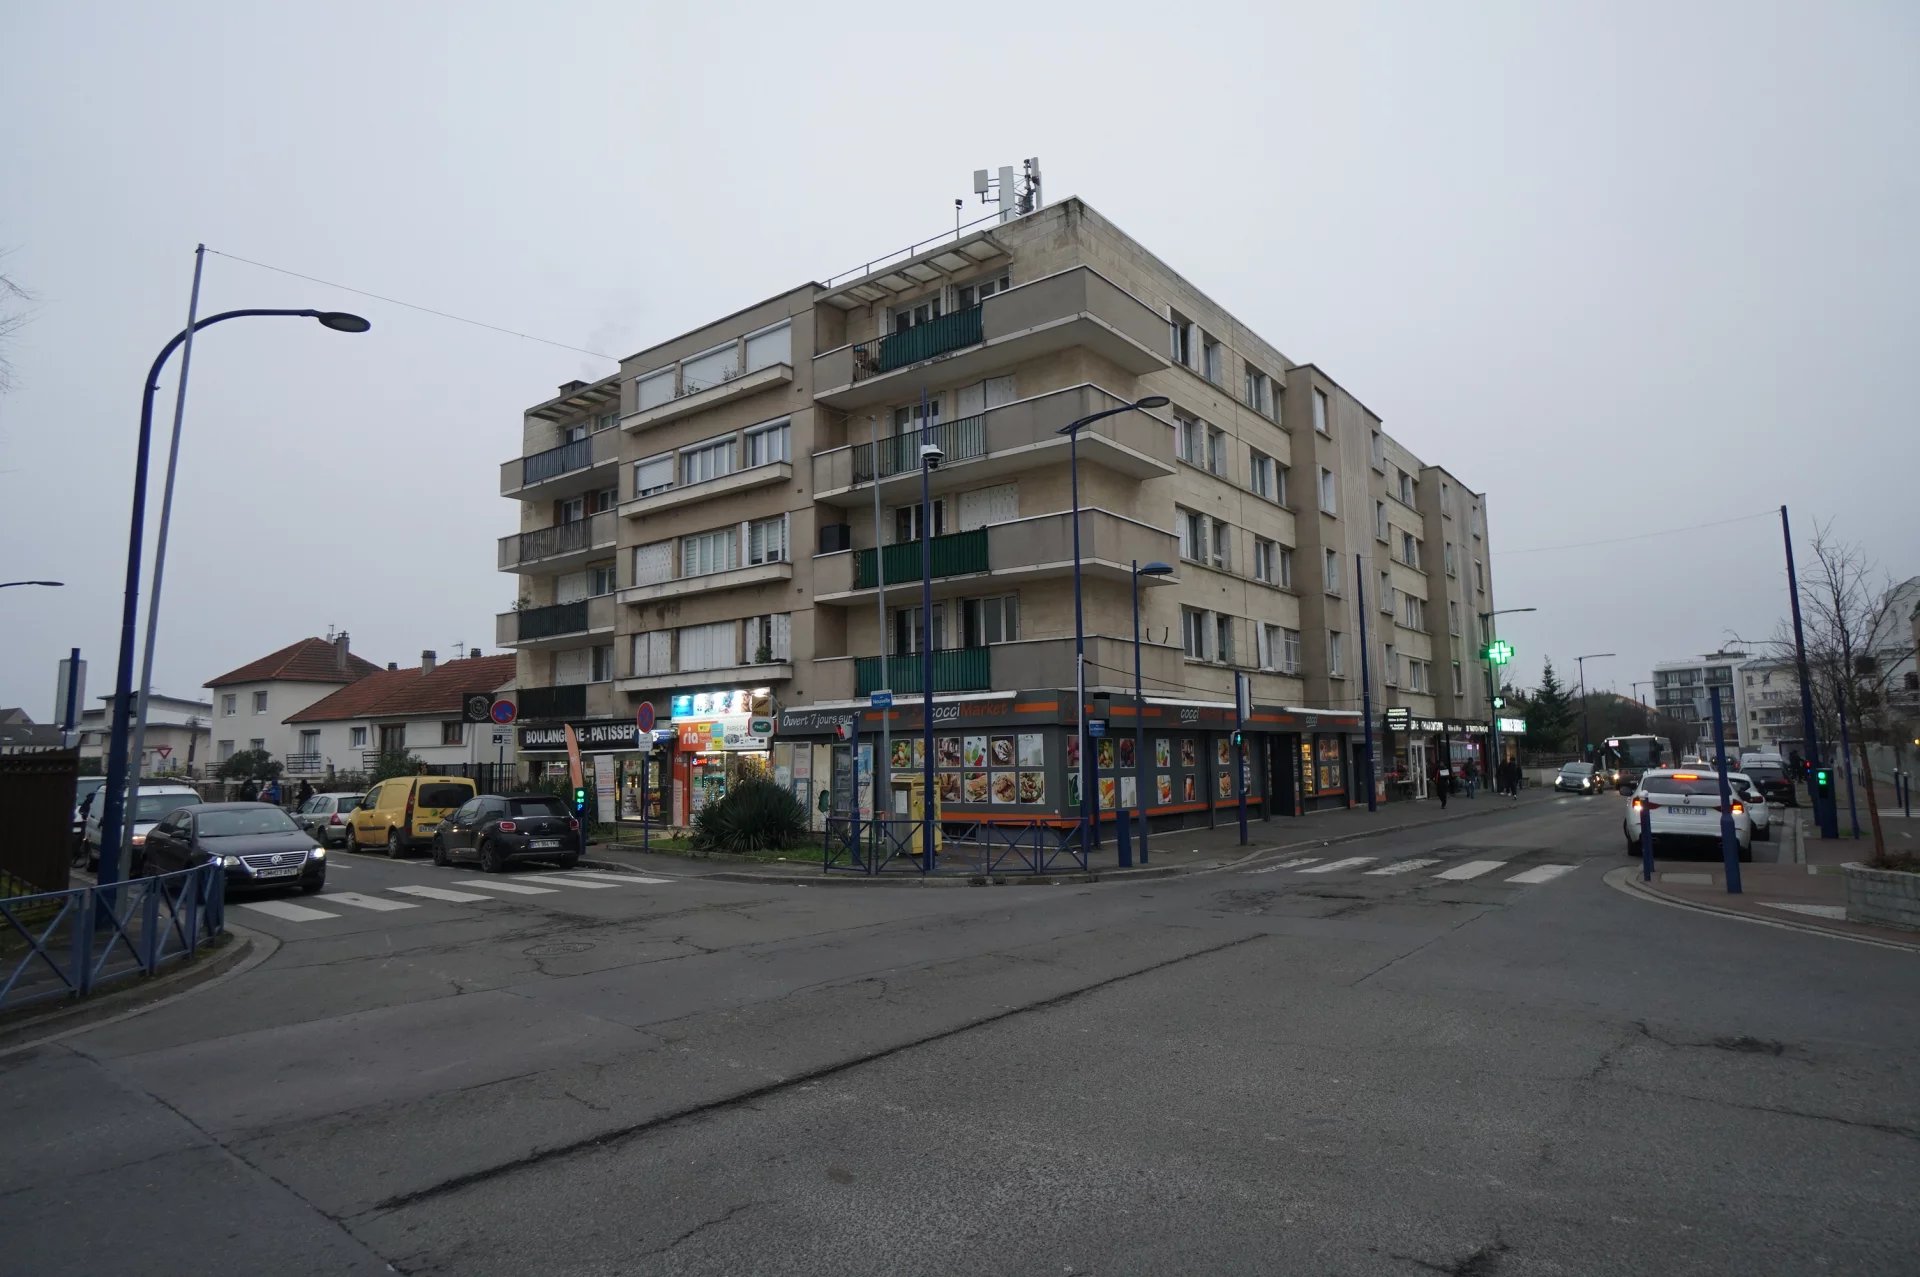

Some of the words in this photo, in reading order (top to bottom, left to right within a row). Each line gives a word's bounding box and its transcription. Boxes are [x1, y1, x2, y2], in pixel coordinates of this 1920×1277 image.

[783, 714, 808, 727] Ouvert
[811, 712, 816, 726] 7
[816, 714, 838, 728] jours
[526, 728, 585, 743] BOULANGIE
[683, 726, 699, 745] ria
